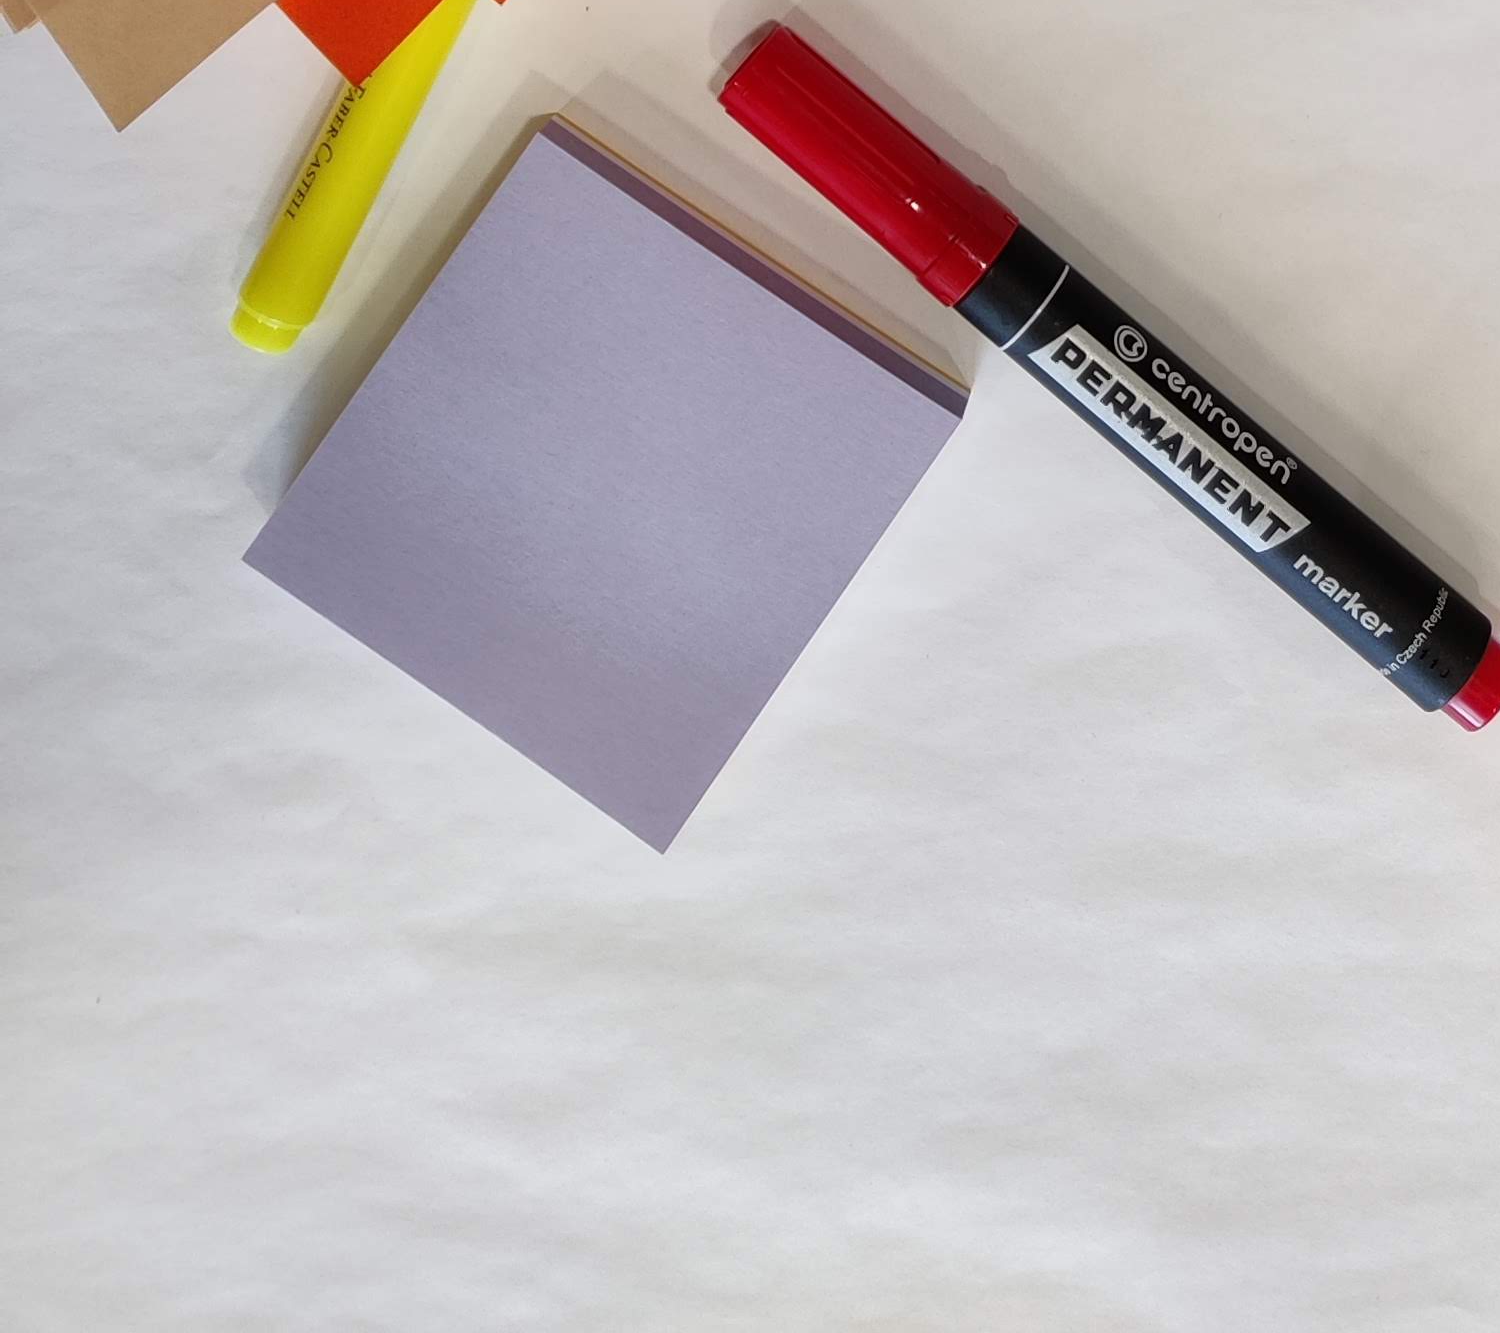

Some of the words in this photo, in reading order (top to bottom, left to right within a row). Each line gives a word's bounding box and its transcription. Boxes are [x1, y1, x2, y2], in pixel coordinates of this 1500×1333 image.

[1051, 337, 1292, 545] PERMANENT
[1293, 554, 1393, 638] marker
[1395, 632, 1427, 665] Czech
